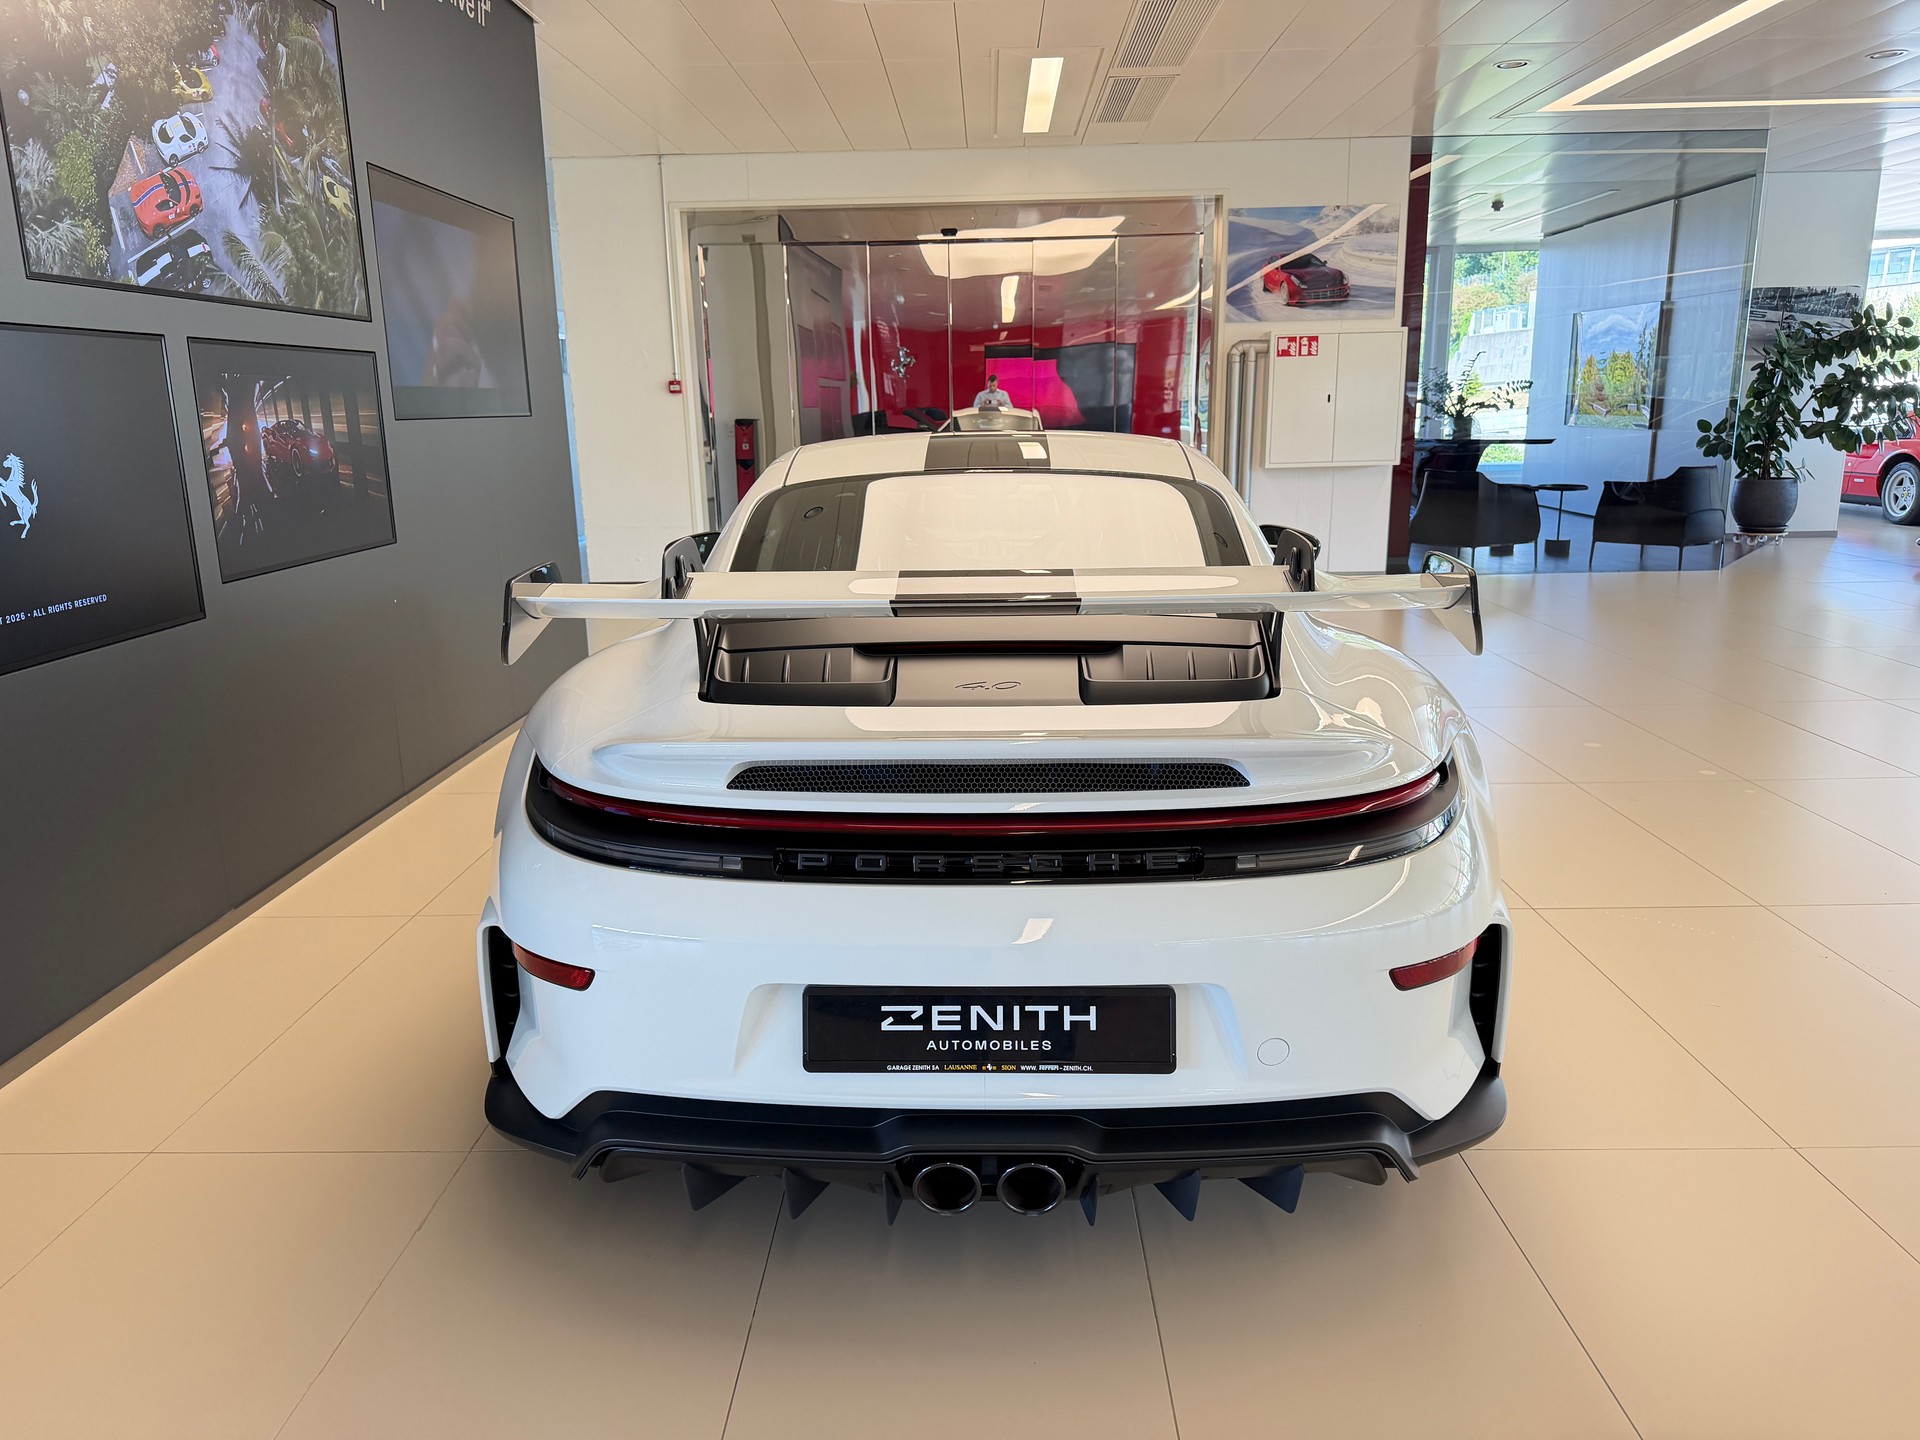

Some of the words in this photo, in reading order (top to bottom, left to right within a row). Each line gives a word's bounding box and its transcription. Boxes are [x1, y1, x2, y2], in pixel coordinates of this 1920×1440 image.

[5, 612, 26, 624] 2026
[33, 608, 47, 618] ALL
[48, 601, 73, 614] RIGHTS
[74, 594, 108, 608] RESERVED
[797, 851, 1180, 873] PORSCHE
[880, 1005, 1097, 1031] ZENITH
[926, 1039, 1052, 1051] AUTOMOBILES
